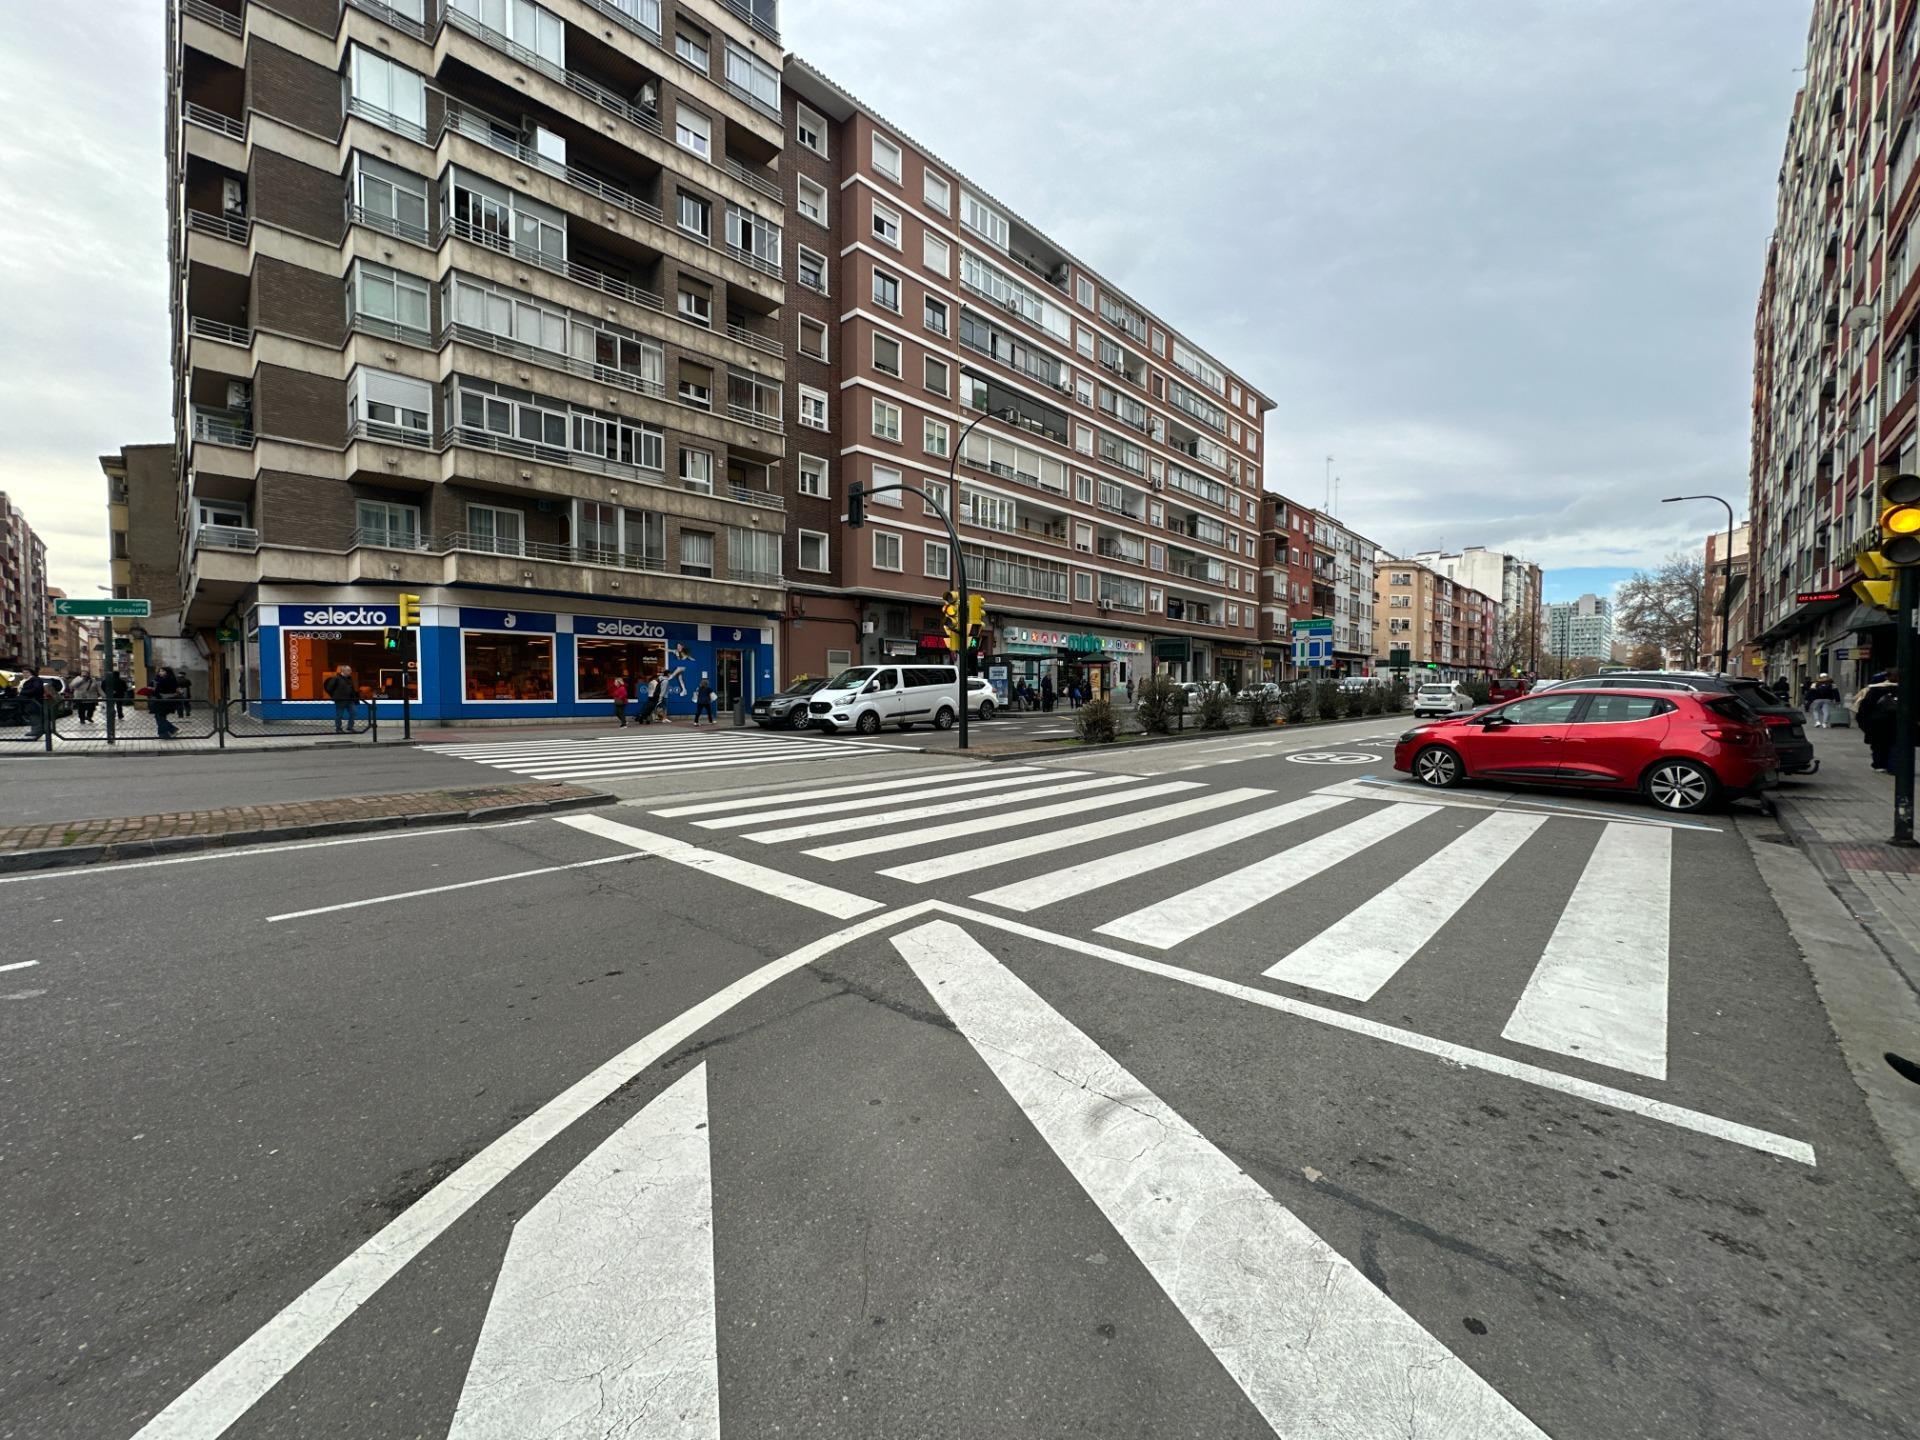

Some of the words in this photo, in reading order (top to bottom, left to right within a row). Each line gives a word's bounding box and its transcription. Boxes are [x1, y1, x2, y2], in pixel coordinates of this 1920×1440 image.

[303, 606, 387, 625] selectro
[596, 619, 665, 637] selectro
[1294, 752, 1371, 764] 30
